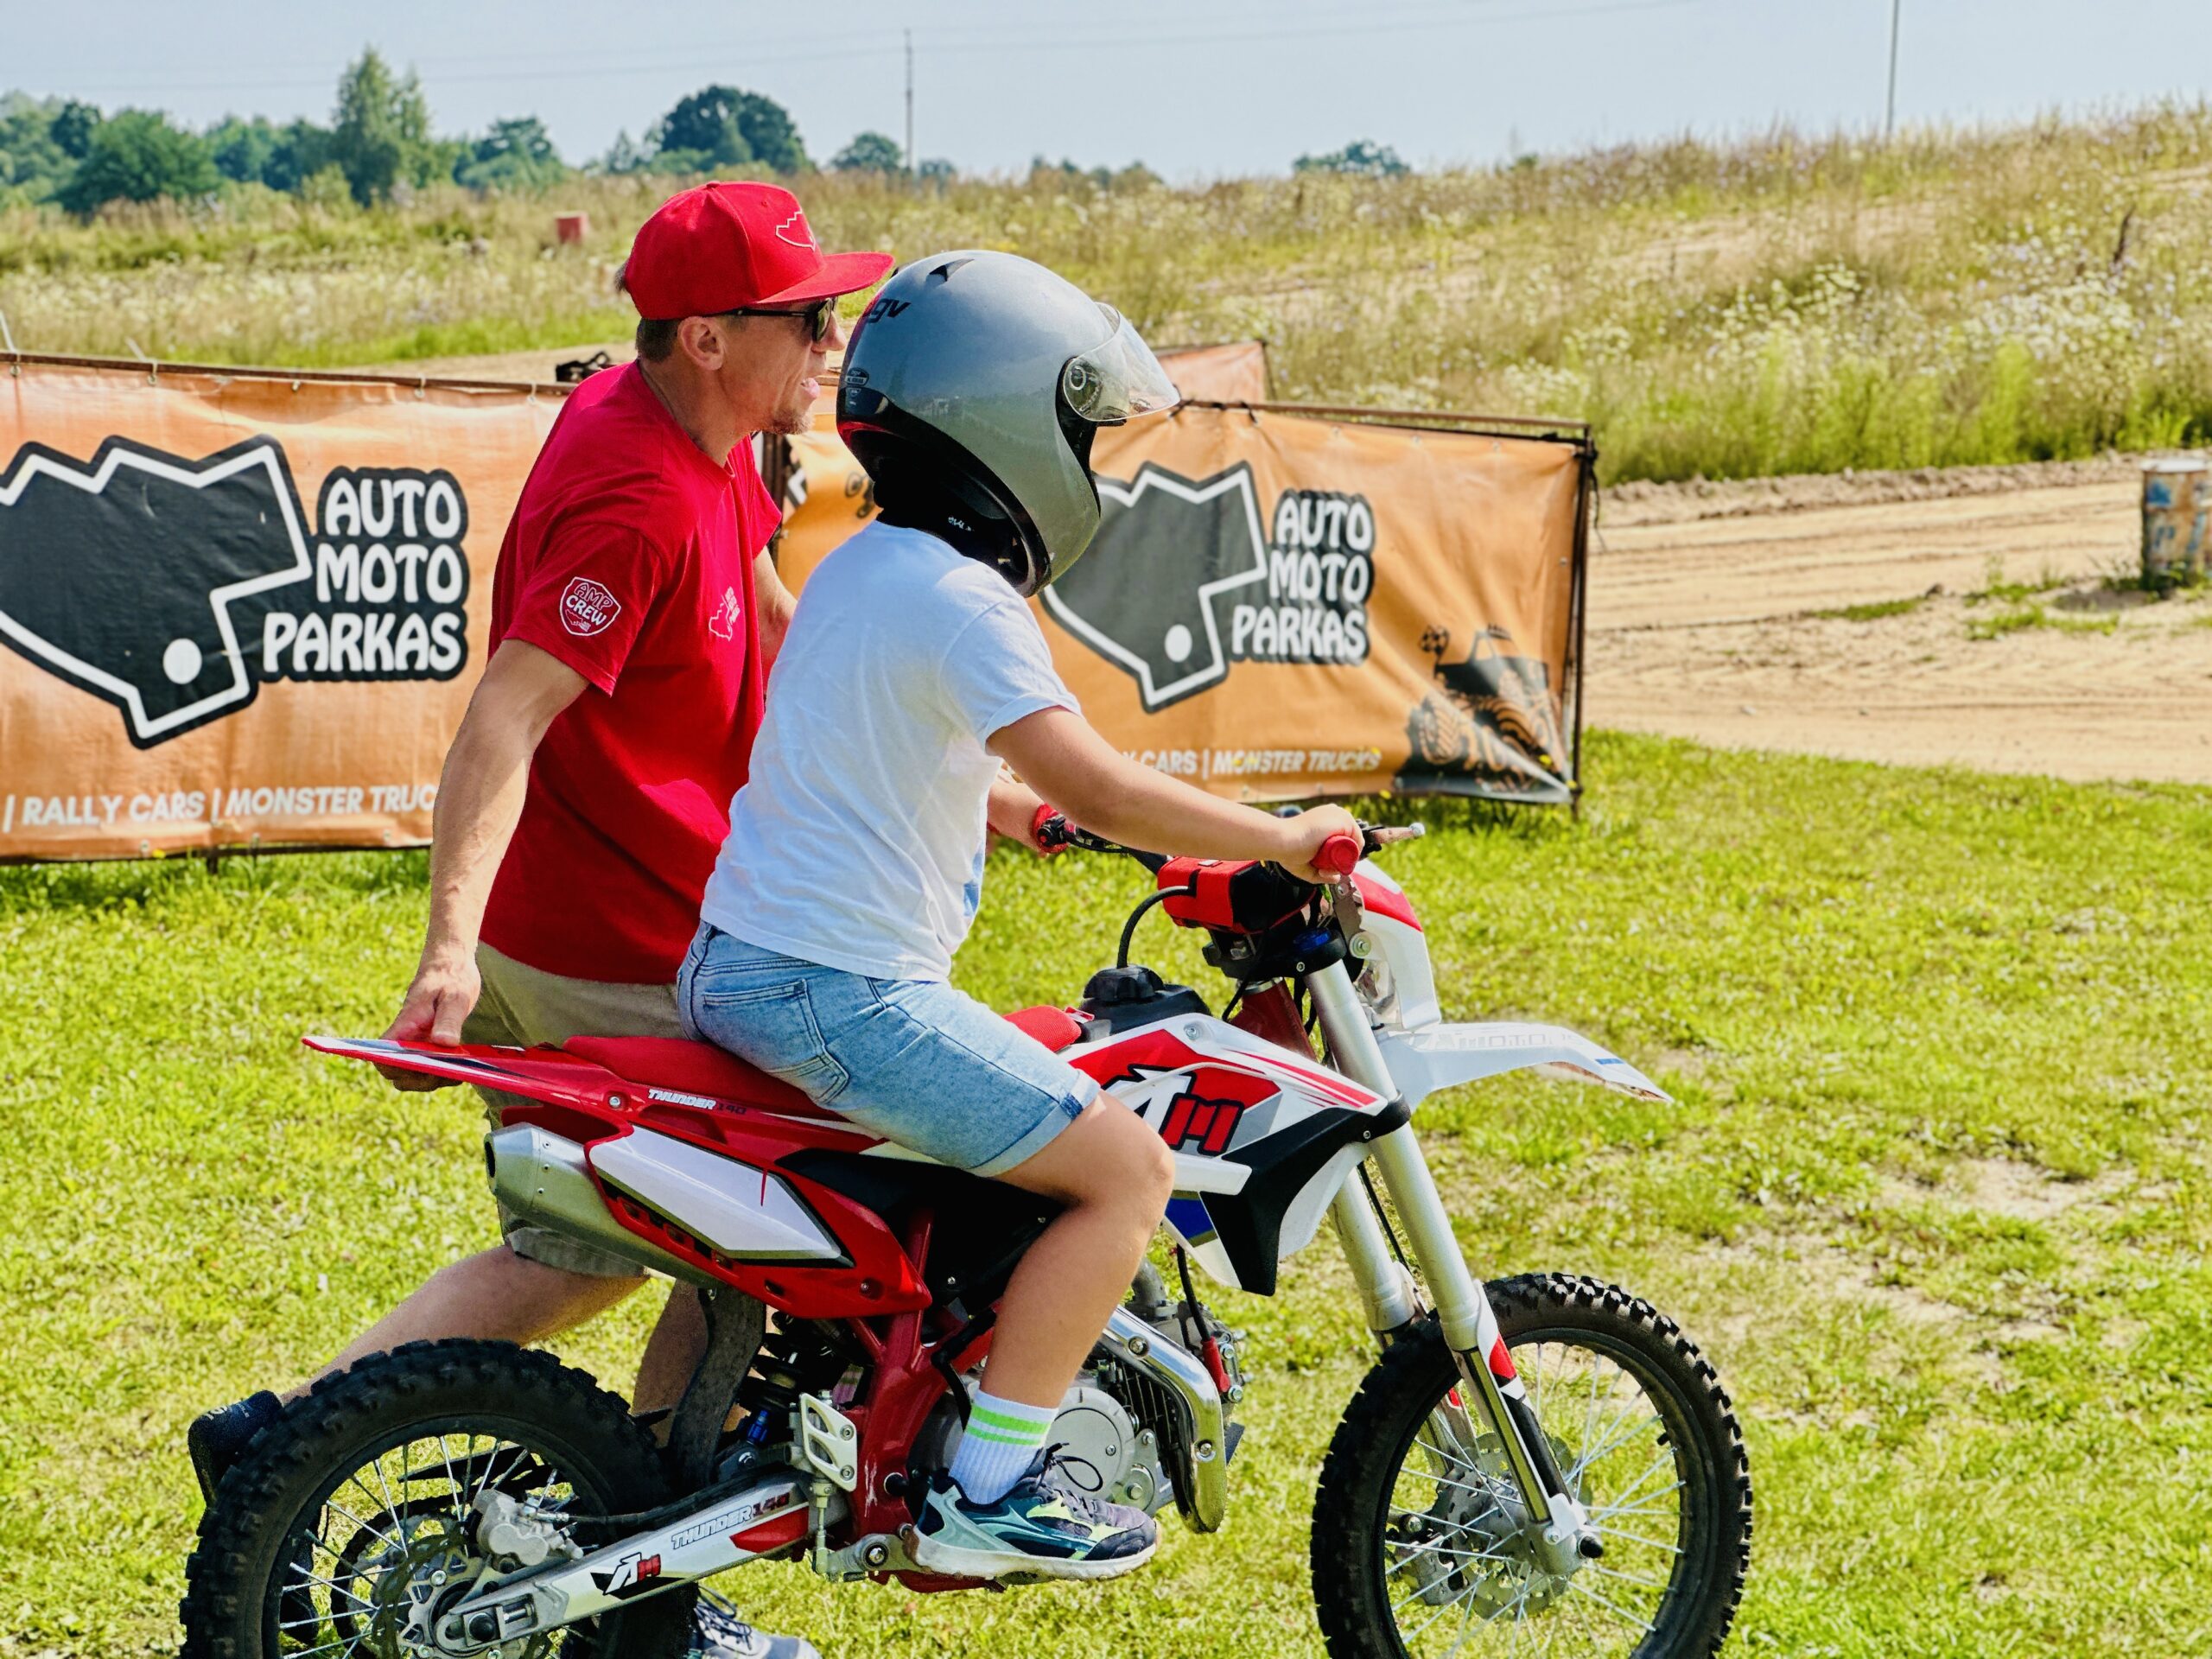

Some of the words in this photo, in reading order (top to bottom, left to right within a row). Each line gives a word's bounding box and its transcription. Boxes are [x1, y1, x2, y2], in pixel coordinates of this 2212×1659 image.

[325, 477, 461, 538] AUTO
[1277, 496, 1373, 550] AUTO
[316, 543, 463, 603] MOTO
[574, 582, 613, 610] AMP
[1269, 551, 1370, 604] MOTO
[566, 594, 607, 626] CREW
[1231, 604, 1368, 660] PARKAS
[264, 613, 461, 672] PARKAS
[1140, 749, 1198, 776] CARS
[1212, 749, 1306, 775] MONSTER
[1307, 748, 1382, 772] TRUCKS
[22, 794, 123, 826] RALLY
[130, 790, 206, 821] CARS
[225, 785, 364, 817] MONSTER
[648, 1088, 716, 1110] THUNDER
[671, 1504, 752, 1550] THUNDER
